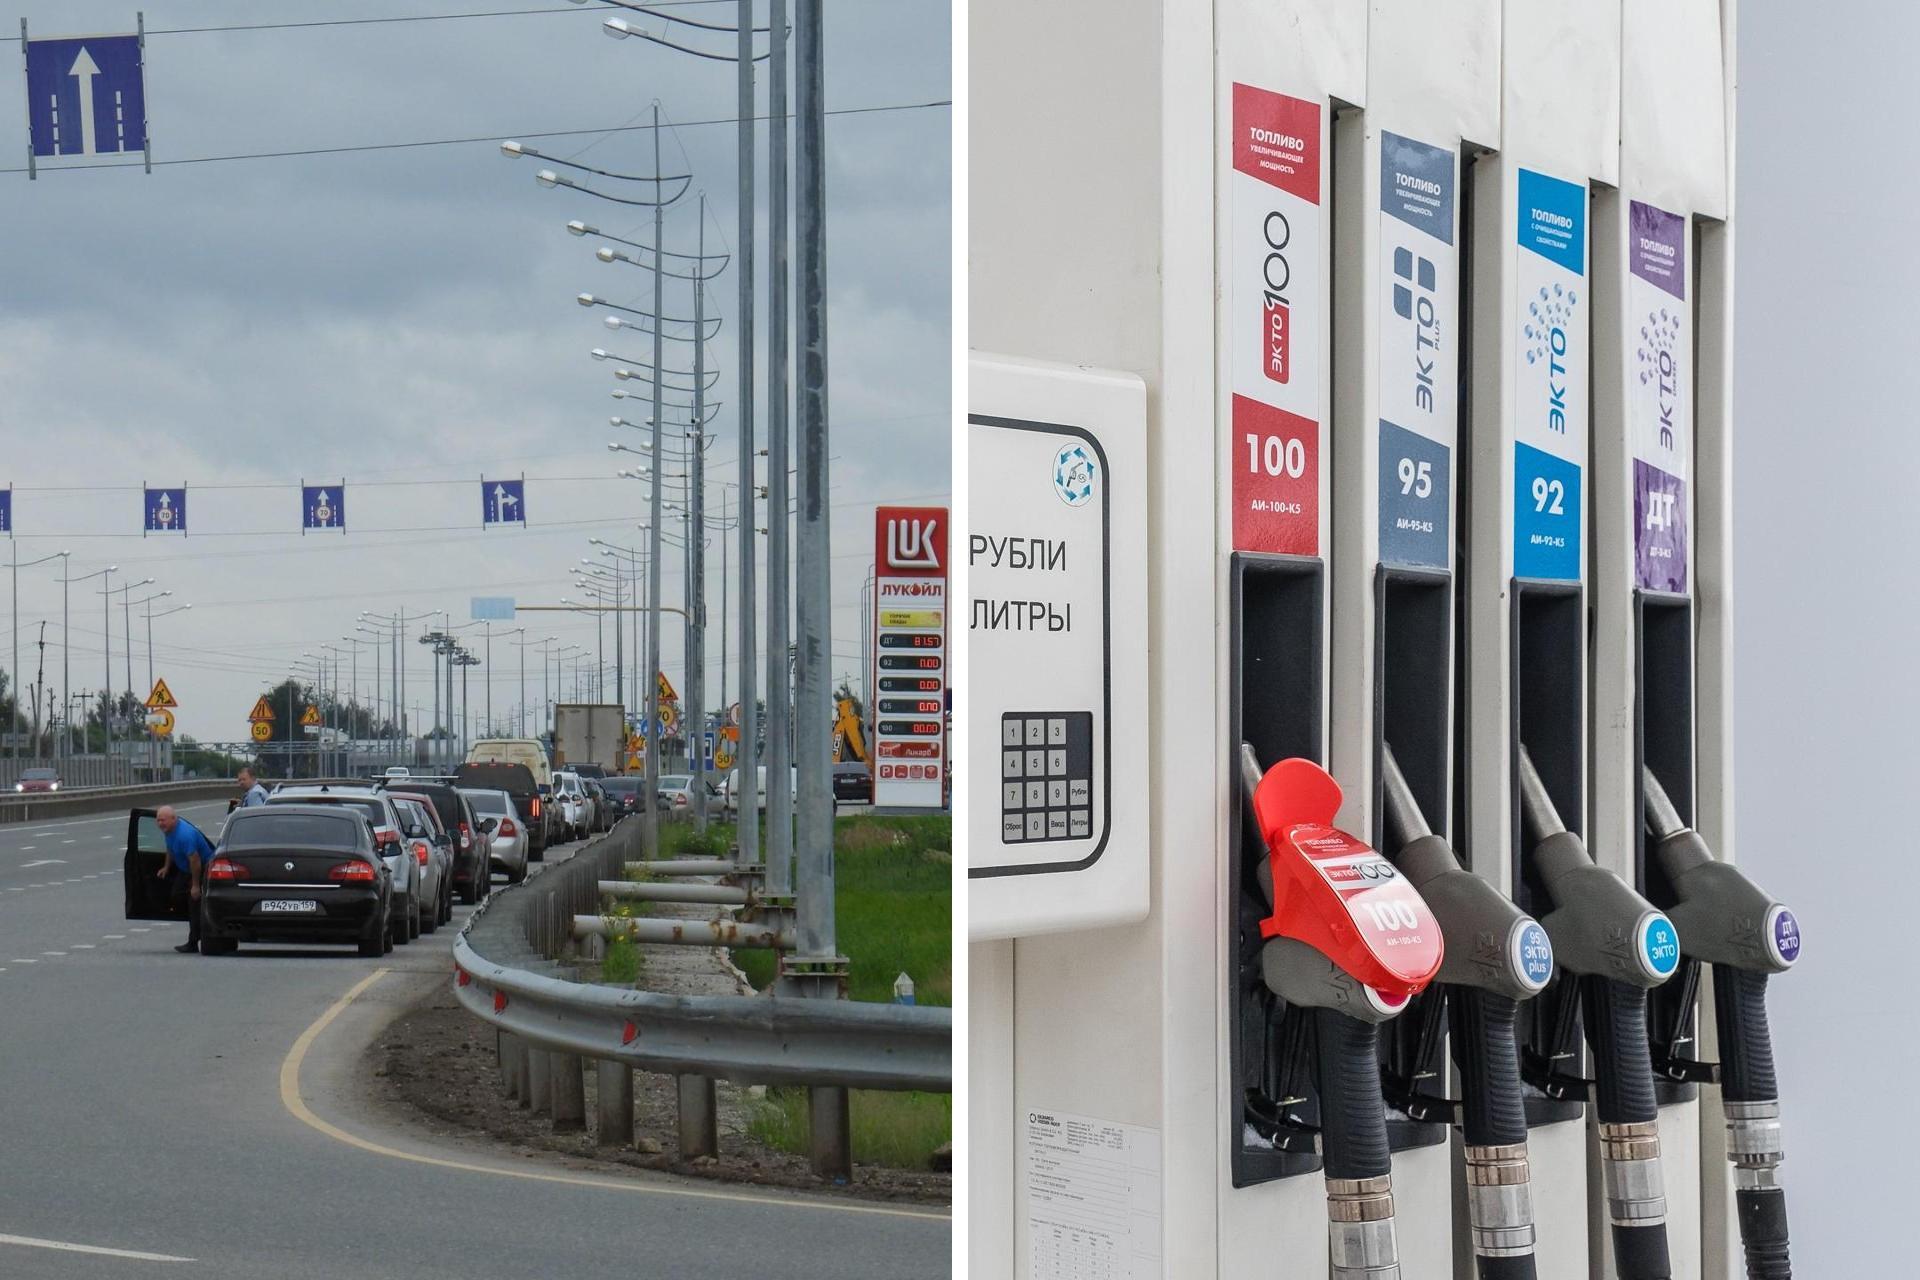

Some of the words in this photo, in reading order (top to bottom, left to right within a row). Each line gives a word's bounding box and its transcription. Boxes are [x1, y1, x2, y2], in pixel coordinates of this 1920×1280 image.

[1250, 127, 1304, 151] ТОПЛИВО
[1260, 160, 1295, 174] МОЩНОСТЬ
[1396, 173, 1441, 196] ТОПЛИВО
[1531, 208, 1573, 229] ТОПЛИВО
[1640, 238, 1675, 257] ТОПЛИВО
[1272, 314, 1283, 374] ЭКТО
[1416, 296, 1434, 413] ЭКТО
[1550, 327, 1566, 435] ЭКТО
[1659, 350, 1673, 452] ЭКТО
[1246, 433, 1305, 479] 100
[1398, 458, 1432, 499] 95
[1532, 477, 1564, 515] 92
[320, 509, 329, 517] 70
[1251, 499, 1301, 515] АИ-100-К5
[1646, 491, 1675, 532] ДТ
[1396, 518, 1433, 533] АИ-95-К5
[1530, 534, 1565, 547] АИ-92-К5
[969, 534, 1066, 571] РУБЛИ
[970, 599, 1071, 632] ЛИТРЫ
[256, 726, 268, 735] 50
[1011, 728, 1016, 737] 1
[1032, 728, 1038, 737] 2
[1055, 727, 1060, 737] 3
[717, 753, 730, 764] 50
[1010, 759, 1016, 768] 4
[1033, 759, 1038, 768] 5
[1055, 758, 1060, 767] 6
[1011, 791, 1016, 800] 7
[1033, 790, 1038, 799] 8
[1055, 789, 1060, 798] 9
[1033, 821, 1039, 830] 0
[1361, 901, 1418, 931] 100
[1783, 921, 1792, 937] ДТ
[1530, 931, 1541, 945] 95
[1656, 931, 1668, 944] 92
[1779, 936, 1799, 951] ЭКТО
[1524, 946, 1549, 960] ЭКТО
[1652, 945, 1676, 960] ЭКТО
[1529, 960, 1547, 976] plus
